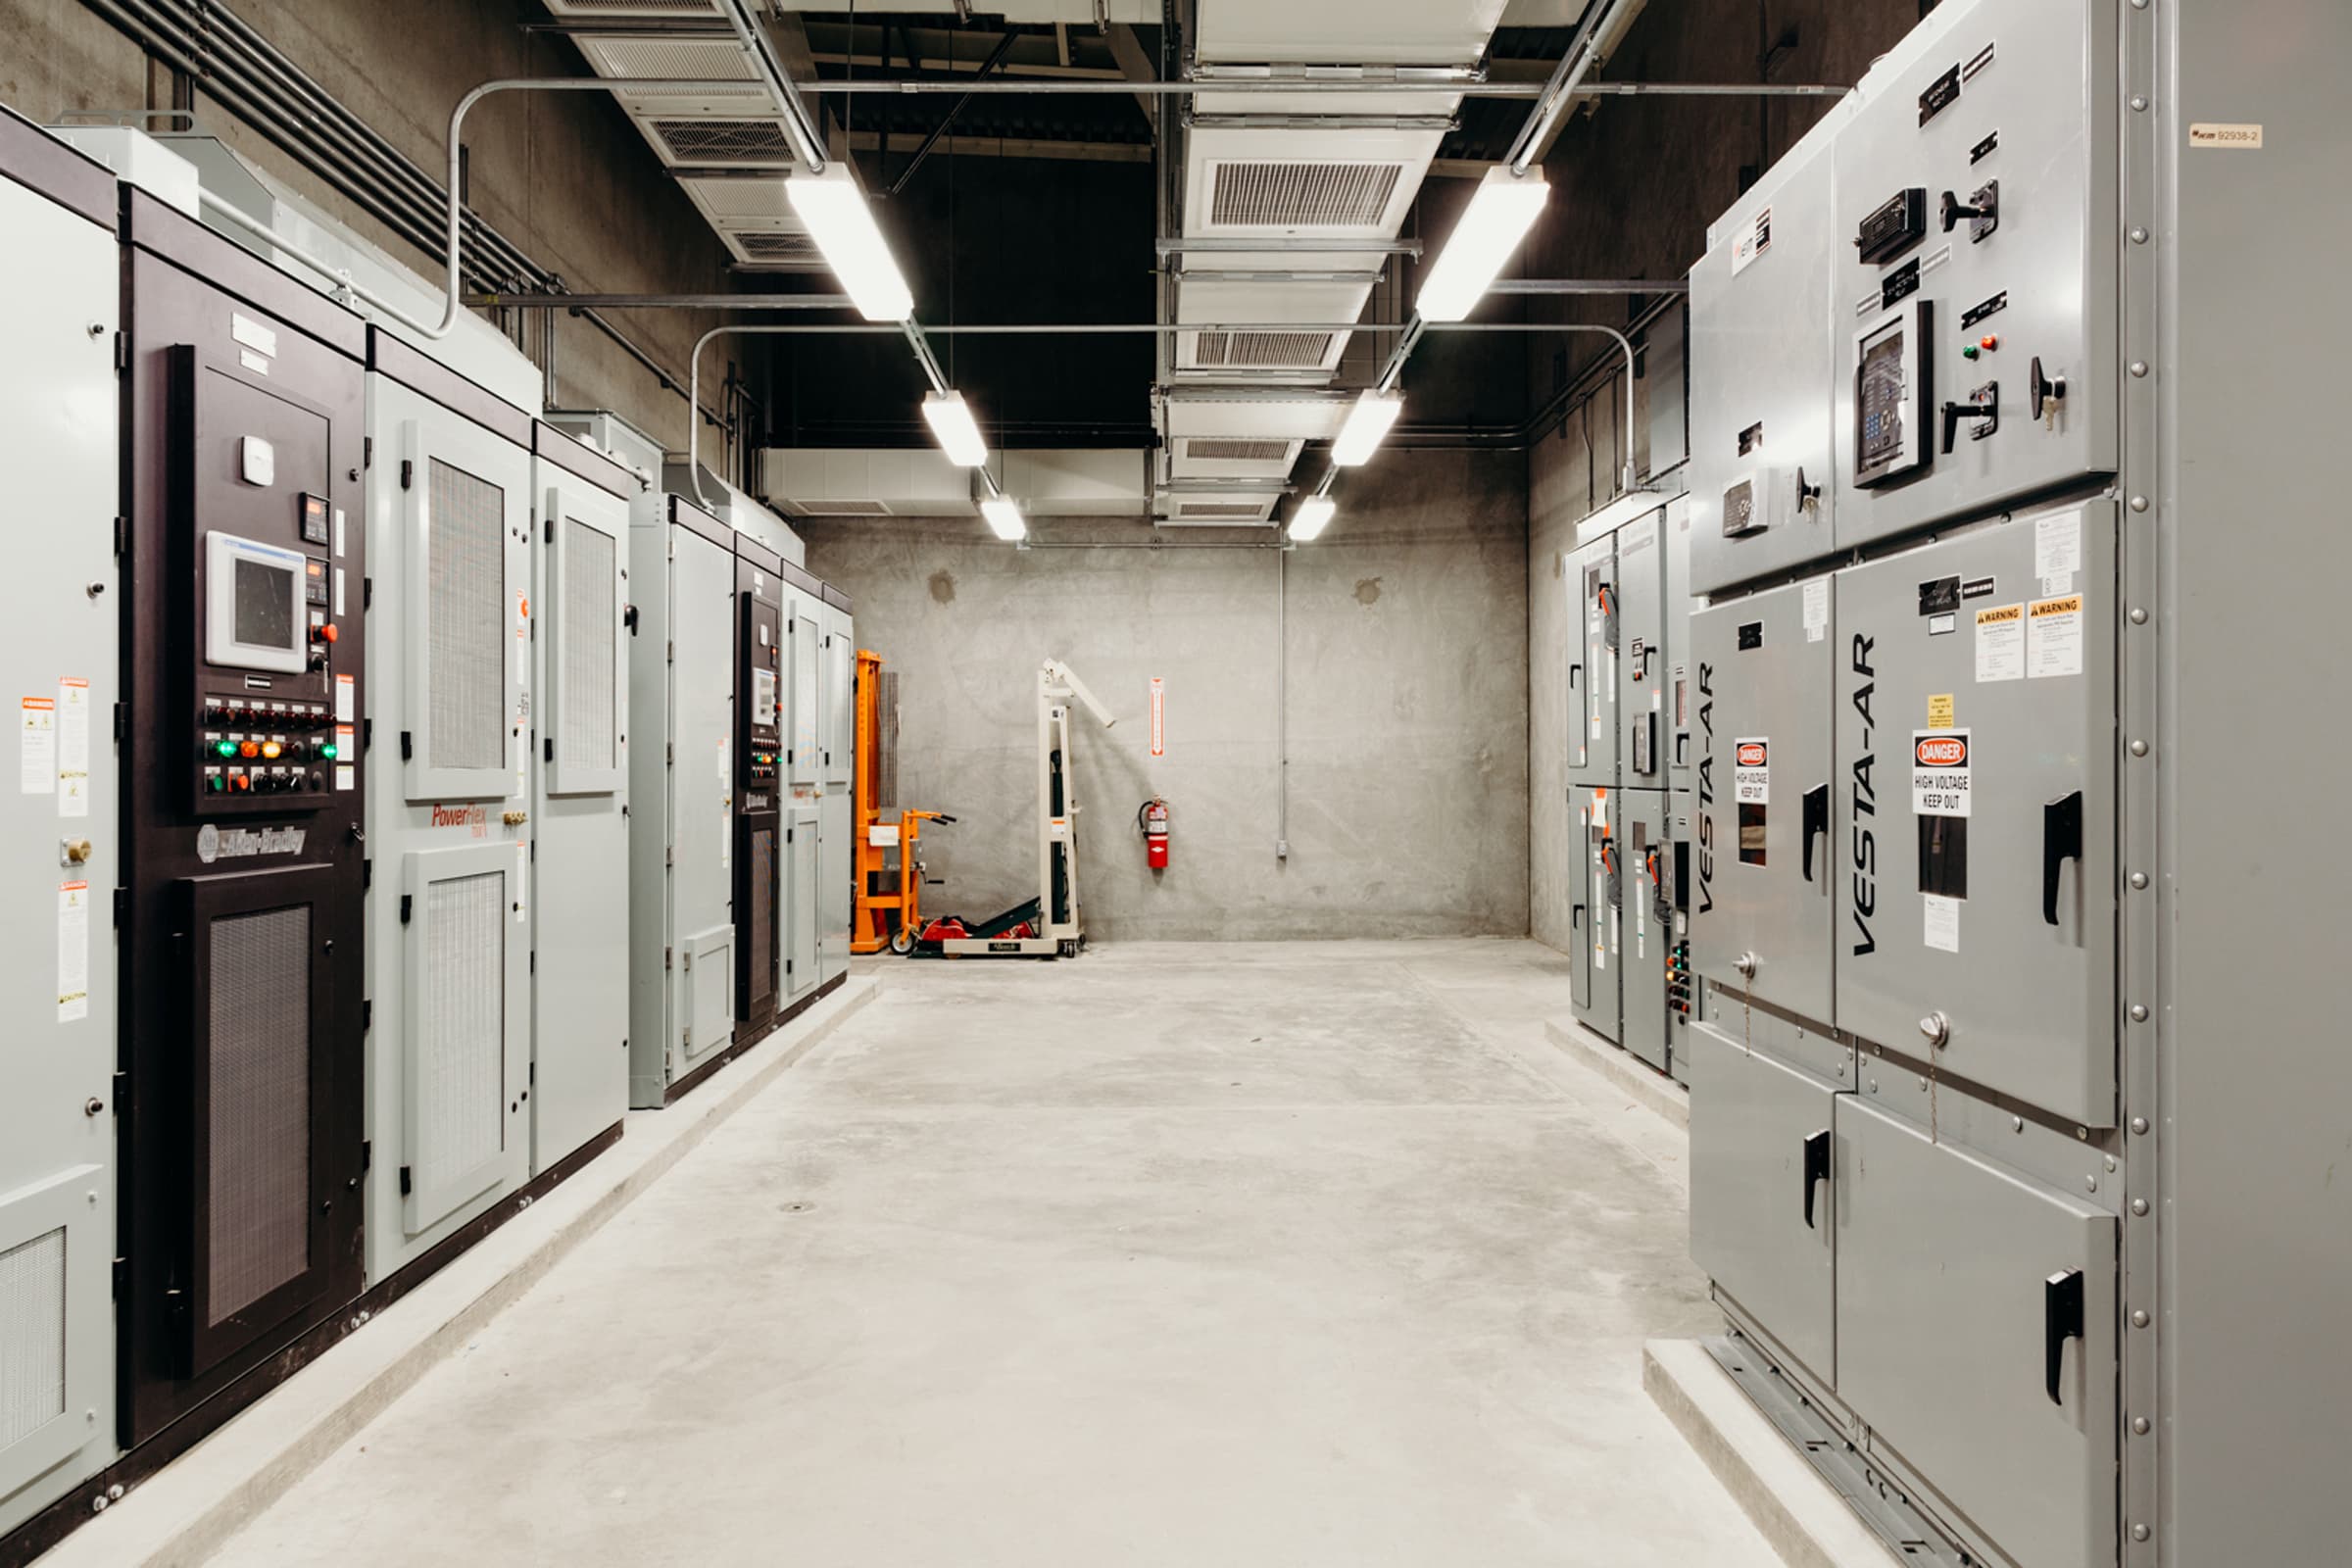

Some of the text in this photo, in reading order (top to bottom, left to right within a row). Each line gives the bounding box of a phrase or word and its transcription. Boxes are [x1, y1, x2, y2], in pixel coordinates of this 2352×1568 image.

[2038, 600, 2078, 615] WARNING
[1984, 609, 2019, 623] WARNING
[1740, 748, 1763, 761] DANGER
[1922, 743, 1961, 760] DANGER
[1699, 662, 1713, 913] VESTA-AR
[1914, 775, 1969, 791] HIGH VOLTAGE
[1853, 633, 1875, 956] VESTA-AR
[1923, 794, 1960, 809] KEEP OUT
[431, 802, 487, 827] PowerFlex
